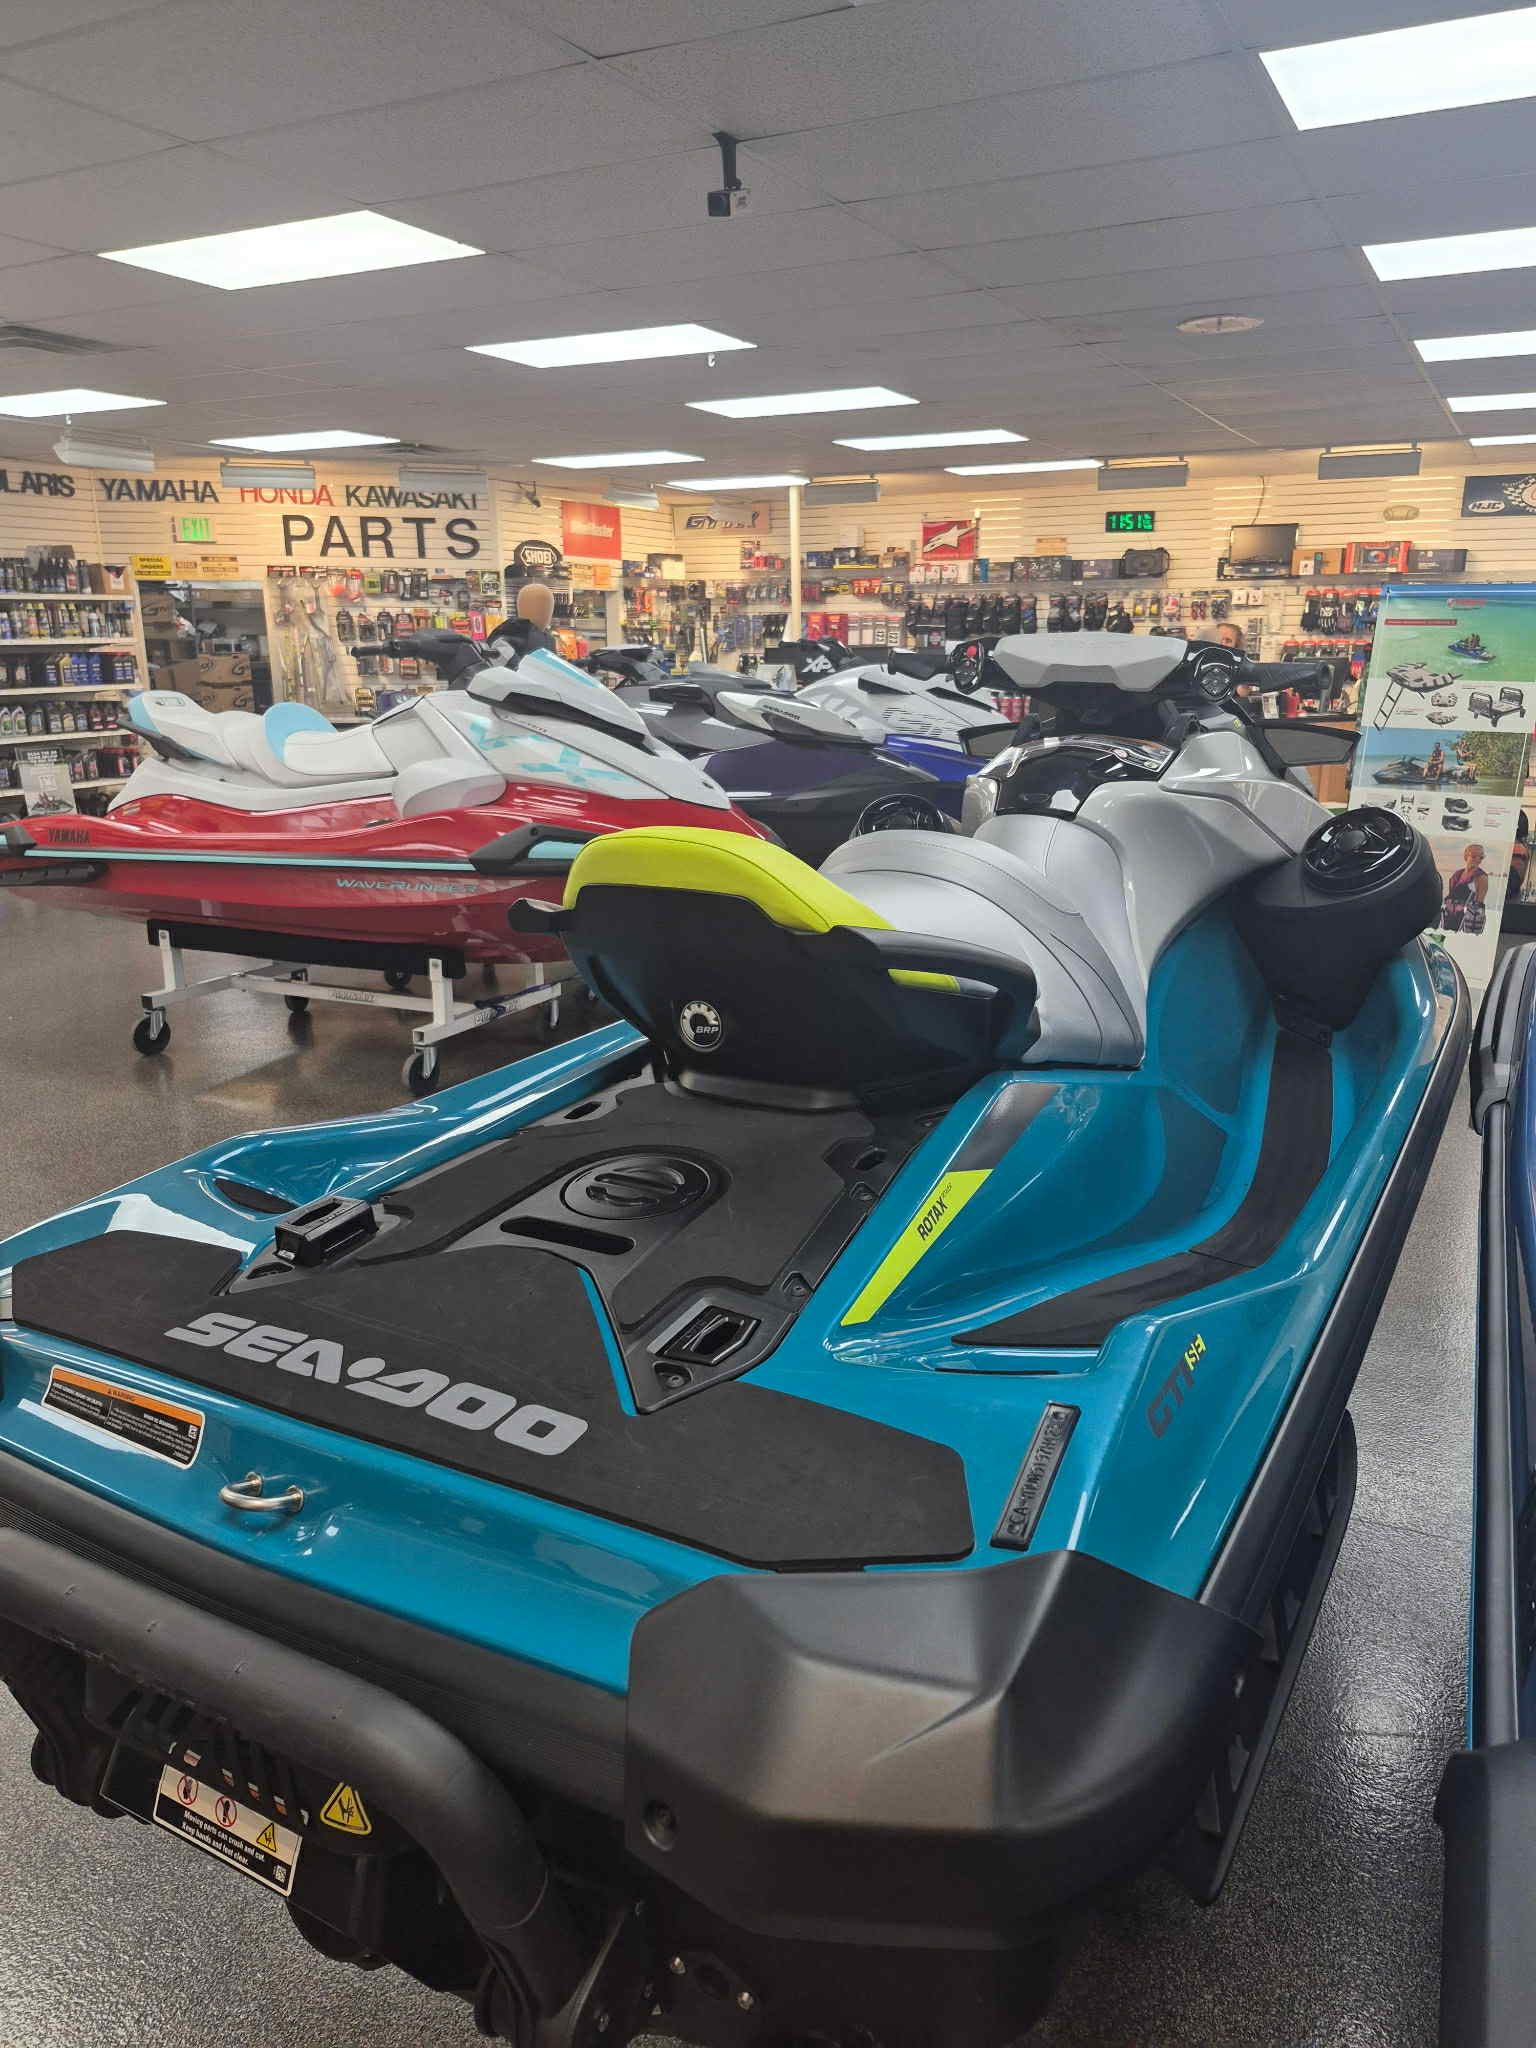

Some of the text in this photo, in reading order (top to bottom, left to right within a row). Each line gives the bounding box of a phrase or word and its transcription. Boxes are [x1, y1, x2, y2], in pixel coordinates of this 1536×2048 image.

[0, 469, 75, 498] LARIS
[99, 478, 220, 503] YAMAHA
[240, 486, 336, 507] HONDA
[182, 517, 209, 540] EXIT
[282, 514, 481, 560] PARTS
[525, 549, 558, 564] SHOEI
[48, 828, 91, 843] YAMAHA
[696, 1026, 719, 1035] BRP
[917, 1196, 948, 1241] ROTAX
[1147, 1358, 1195, 1438] GTI
[184, 1810, 204, 1828] Moving
[203, 1822, 217, 1836] parts
[218, 1831, 228, 1841] can
[228, 1836, 244, 1849] crush
[244, 1844, 255, 1857] and
[195, 1828, 212, 1845] hands
[212, 1836, 223, 1850] and
[222, 1842, 234, 1856] feet
